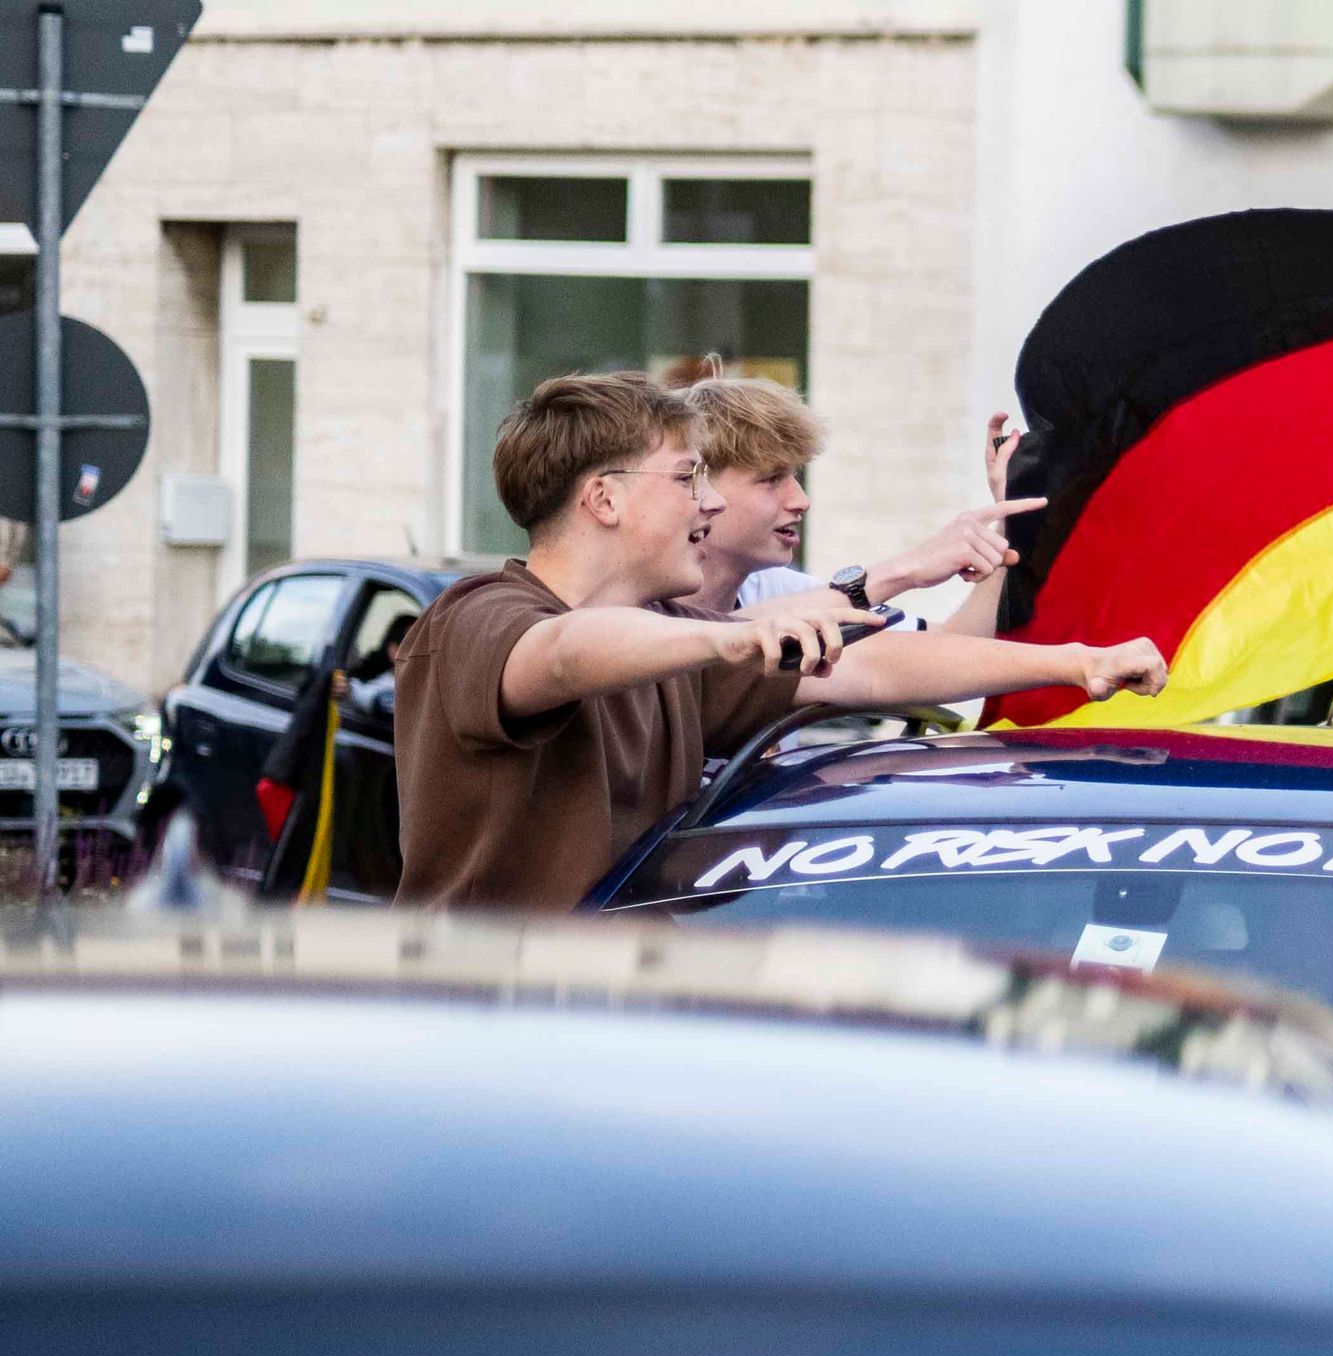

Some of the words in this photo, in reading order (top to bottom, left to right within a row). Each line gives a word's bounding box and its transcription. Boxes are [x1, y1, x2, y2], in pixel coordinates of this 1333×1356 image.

[694, 835, 875, 888] NO
[879, 827, 1145, 869] RISK
[1138, 828, 1323, 868] NO
